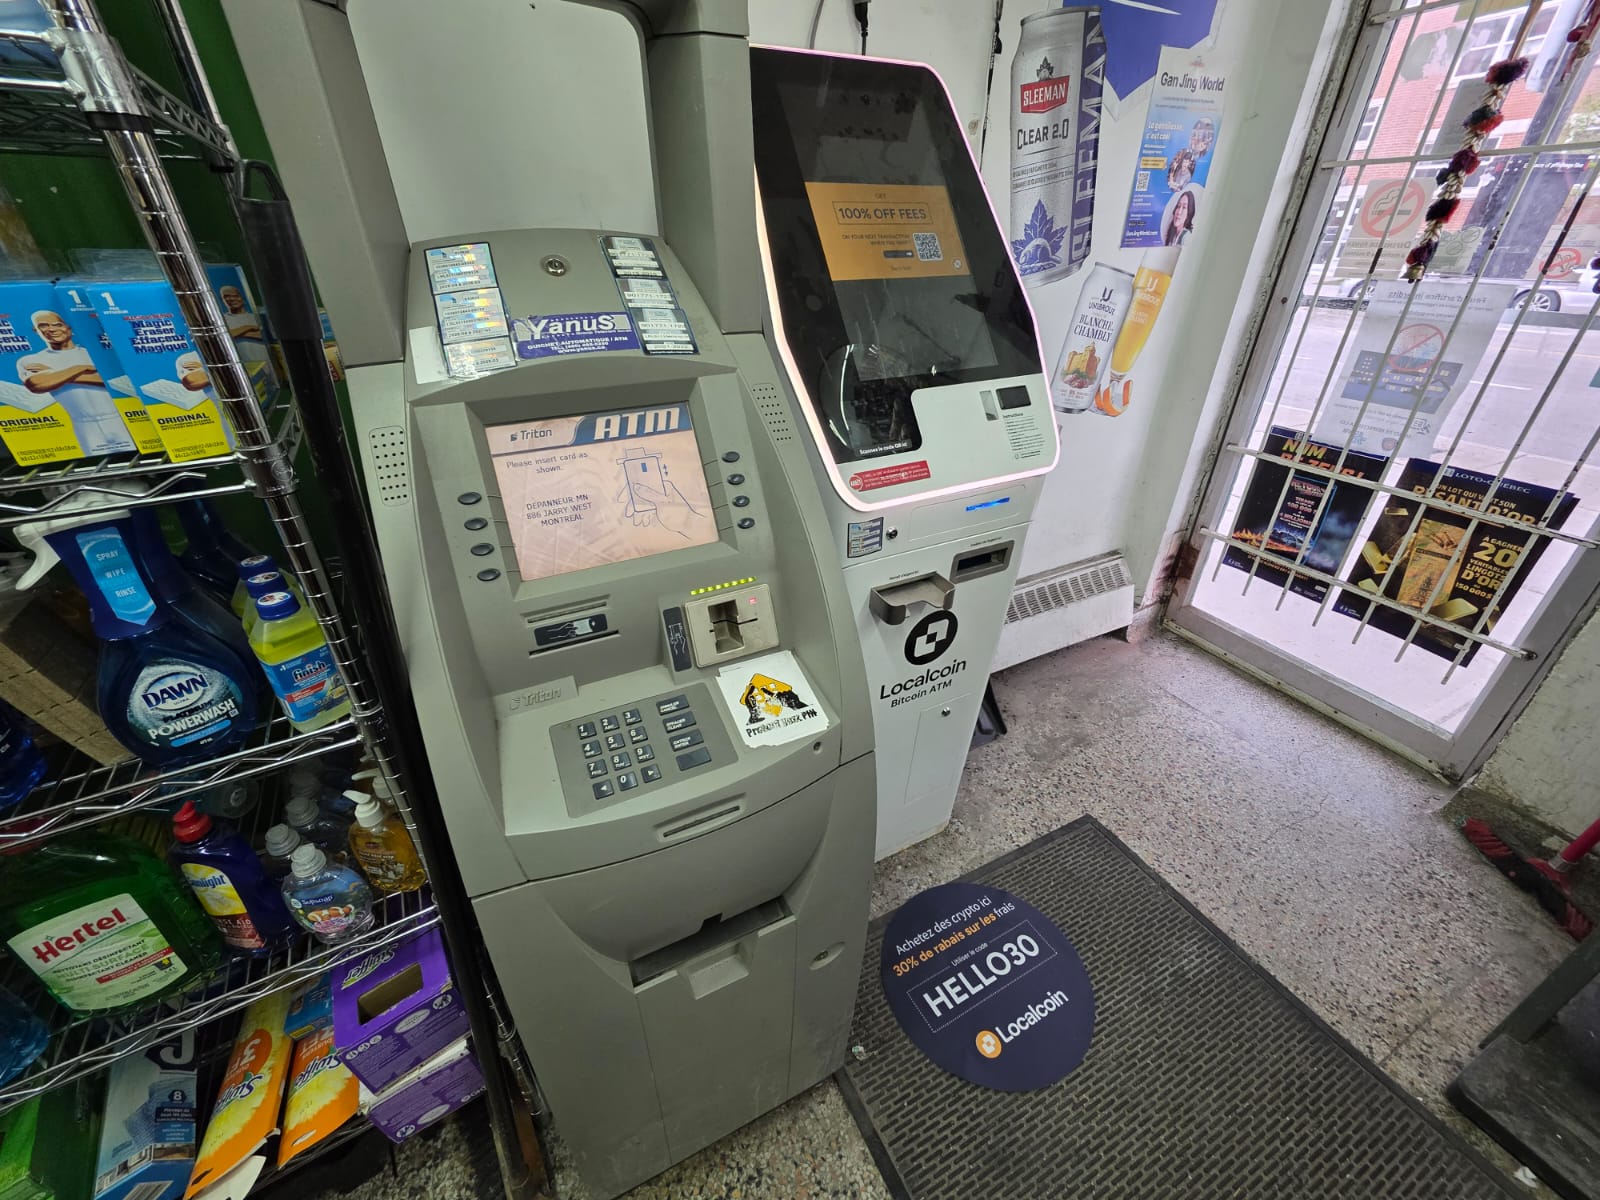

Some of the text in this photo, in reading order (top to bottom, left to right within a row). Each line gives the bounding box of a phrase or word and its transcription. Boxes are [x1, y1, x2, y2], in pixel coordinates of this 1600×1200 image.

[1160, 71, 1226, 93] Gan Jing World
[1023, 83, 1066, 106] SLEEMAN
[1017, 118, 1070, 150] CLEAR 2.0
[838, 207, 927, 220] 100% OFF FEES
[100, 291, 115, 306] 1
[131, 319, 172, 330] Magic
[134, 327, 175, 337] Eraser
[131, 335, 186, 346] Effaceur
[1074, 324, 1112, 343] CHAMBLY
[134, 342, 189, 354] Magique
[0, 415, 59, 427] ORIGINAL
[156, 412, 210, 425] ORIGINAL
[594, 407, 681, 441] ATM
[520, 428, 552, 441] Triton
[506, 460, 533, 469] Please
[535, 455, 557, 464] insert
[559, 452, 576, 461] card
[526, 493, 589, 511] DEPANNEUR MN
[1447, 485, 1463, 494] LOT
[1499, 499, 1518, 510] SON
[543, 506, 568, 517] JARRY
[571, 501, 593, 511] WEST
[541, 513, 584, 527] MONTREAL
[96, 549, 119, 561] SPRAY
[1473, 541, 1519, 568] 20
[104, 567, 127, 579] WIPE
[1461, 569, 1503, 591] D'OR
[114, 586, 137, 598] RINSE
[292, 660, 327, 682] finish
[880, 659, 966, 700] Localcoin
[142, 673, 209, 709] DAWN
[890, 679, 953, 708] Bitcoin ATM
[147, 698, 236, 740] POWERWASH
[602, 718, 609, 726] 2
[607, 736, 614, 744] 5
[630, 729, 636, 737] 6
[584, 743, 591, 751] 4
[637, 748, 643, 756] 9
[589, 763, 595, 771] 7
[613, 755, 620, 763] 8
[620, 775, 627, 783] 0
[896, 895, 992, 955] Achetez des crypto ici
[32, 907, 128, 964] Hertel
[892, 901, 1016, 977] 30% de rabais sur les frais
[951, 942, 988, 967] Utiliser le code
[341, 942, 400, 989] Swiffer
[923, 934, 1040, 1018] HELLO30
[995, 989, 1069, 1044] Localcoin
[173, 1090, 182, 1101] 8
